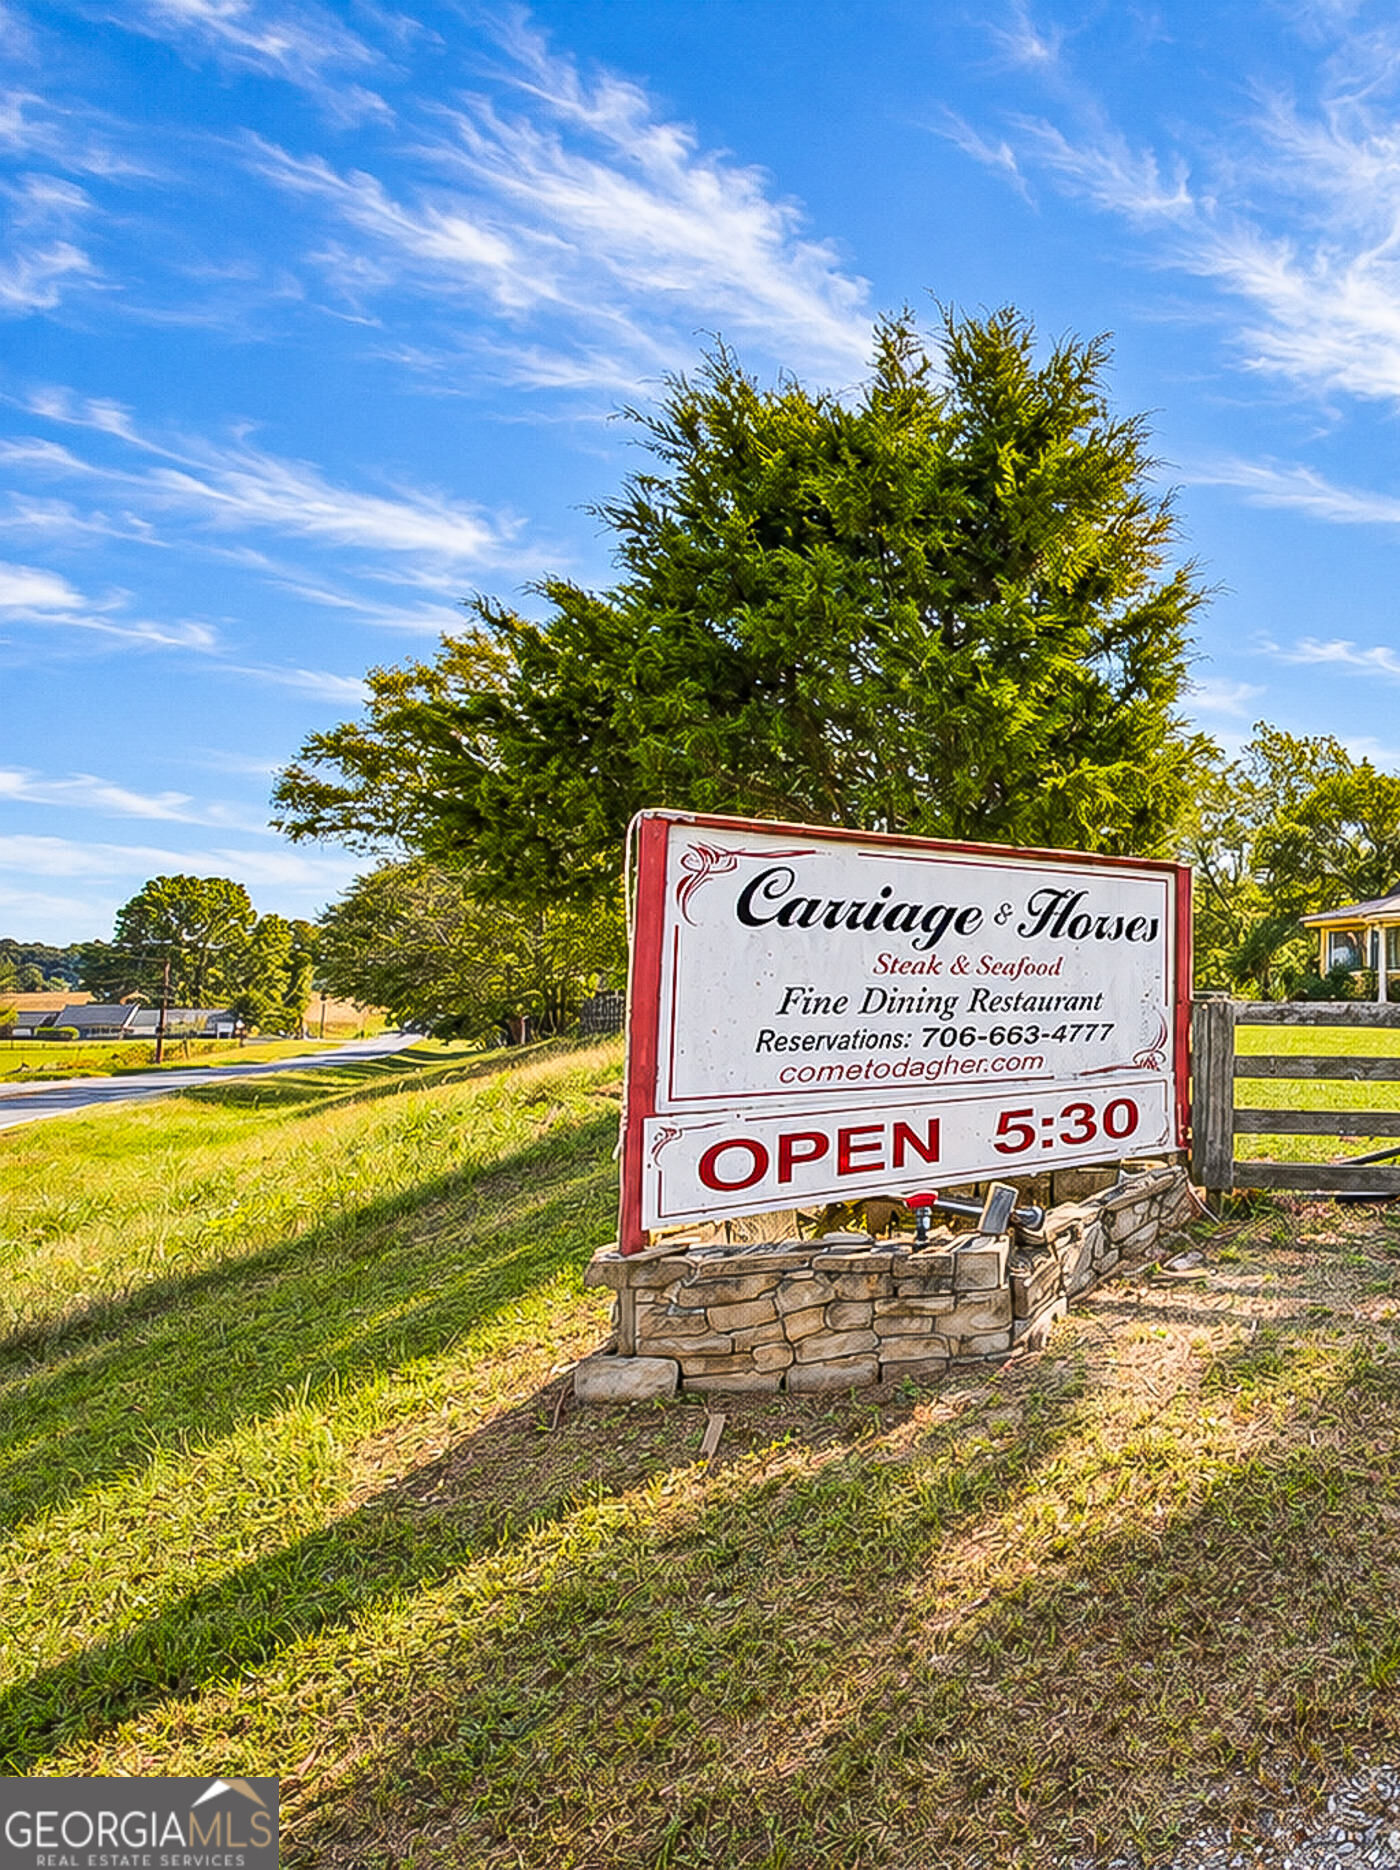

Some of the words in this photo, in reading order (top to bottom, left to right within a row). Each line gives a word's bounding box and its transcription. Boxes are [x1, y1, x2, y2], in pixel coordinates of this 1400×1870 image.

[735, 866, 983, 951] Carriage
[993, 903, 1012, 925] &
[1017, 887, 1159, 943] Horses
[872, 953, 943, 977] Steak
[949, 956, 970, 976] &
[976, 956, 1064, 980] Seafood
[775, 987, 849, 1017] Fine
[857, 987, 960, 1021] Dining
[969, 988, 1104, 1013] Restaurant
[755, 1029, 911, 1053] Reservations:
[921, 1023, 1115, 1048] 706-663-4777
[779, 1053, 1044, 1085] cometodagher.com
[698, 1118, 941, 1191] OPEN
[993, 1098, 1140, 1155] 5:30
